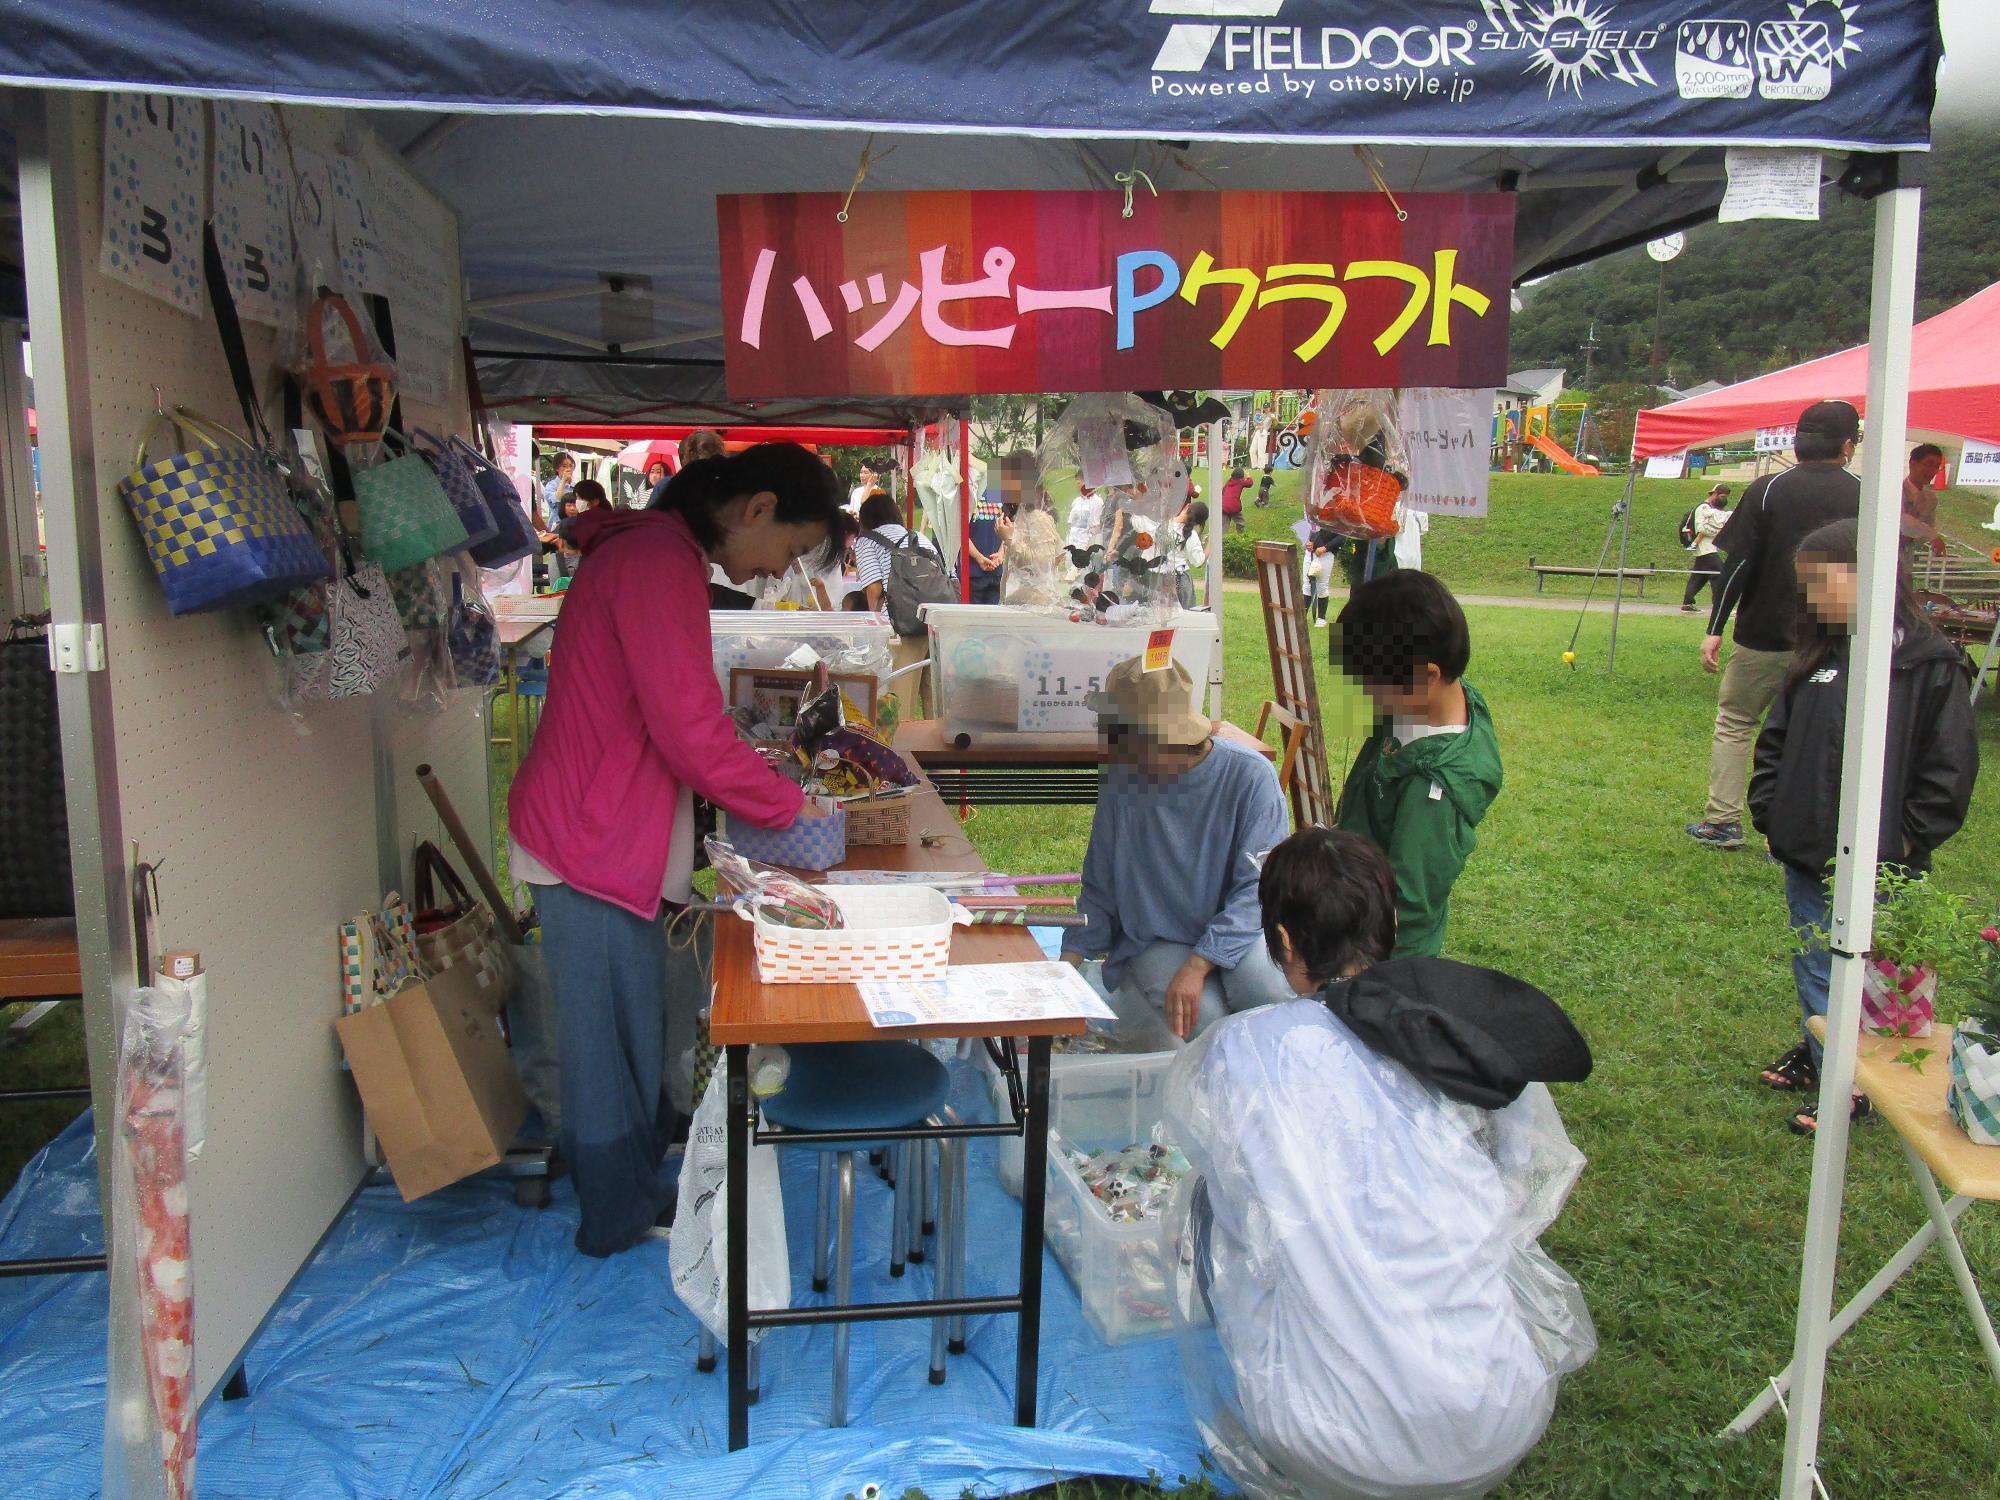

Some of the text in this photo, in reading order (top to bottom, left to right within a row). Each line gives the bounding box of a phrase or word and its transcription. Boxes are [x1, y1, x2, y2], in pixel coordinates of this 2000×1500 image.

[1225, 26, 1477, 70] FIELDOOR
[1478, 31, 1660, 51] SUN SHIELD
[1682, 71, 1750, 86] 2,000mm
[1763, 58, 1810, 83] UV
[1151, 68, 1475, 102] Powered by ottostyle.jp
[1765, 84, 1827, 96] PROTECTION
[740, 245, 1491, 363] ハッピーPクラフト
